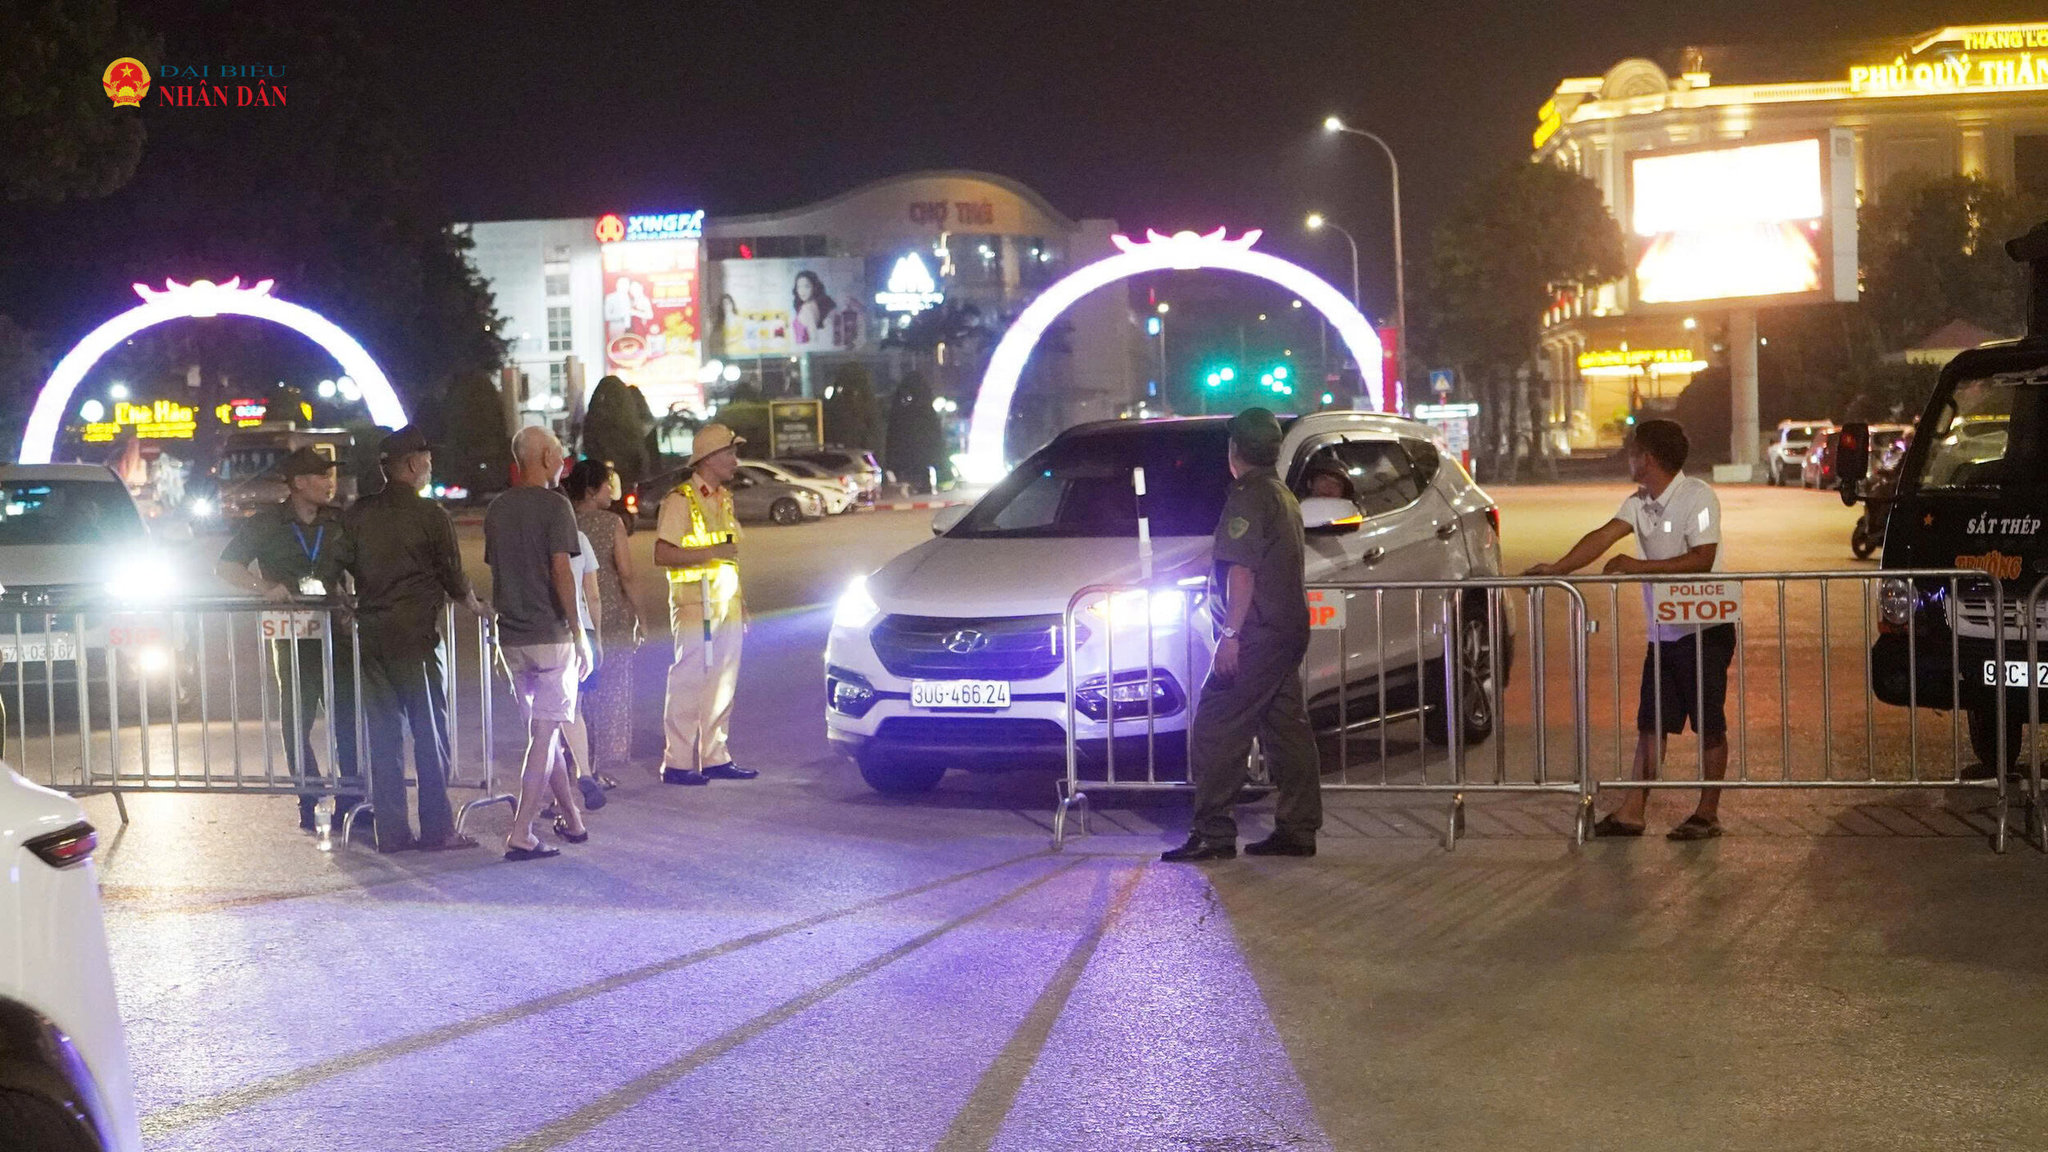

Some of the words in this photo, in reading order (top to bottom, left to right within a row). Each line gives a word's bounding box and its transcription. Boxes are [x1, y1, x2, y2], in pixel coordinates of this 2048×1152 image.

[1849, 56, 1908, 92] PHÚ
[1967, 511, 1997, 534] SẮT
[2001, 515, 2041, 534] THÉP
[1670, 584, 1724, 596] POLICE
[1658, 601, 1738, 620] STOP
